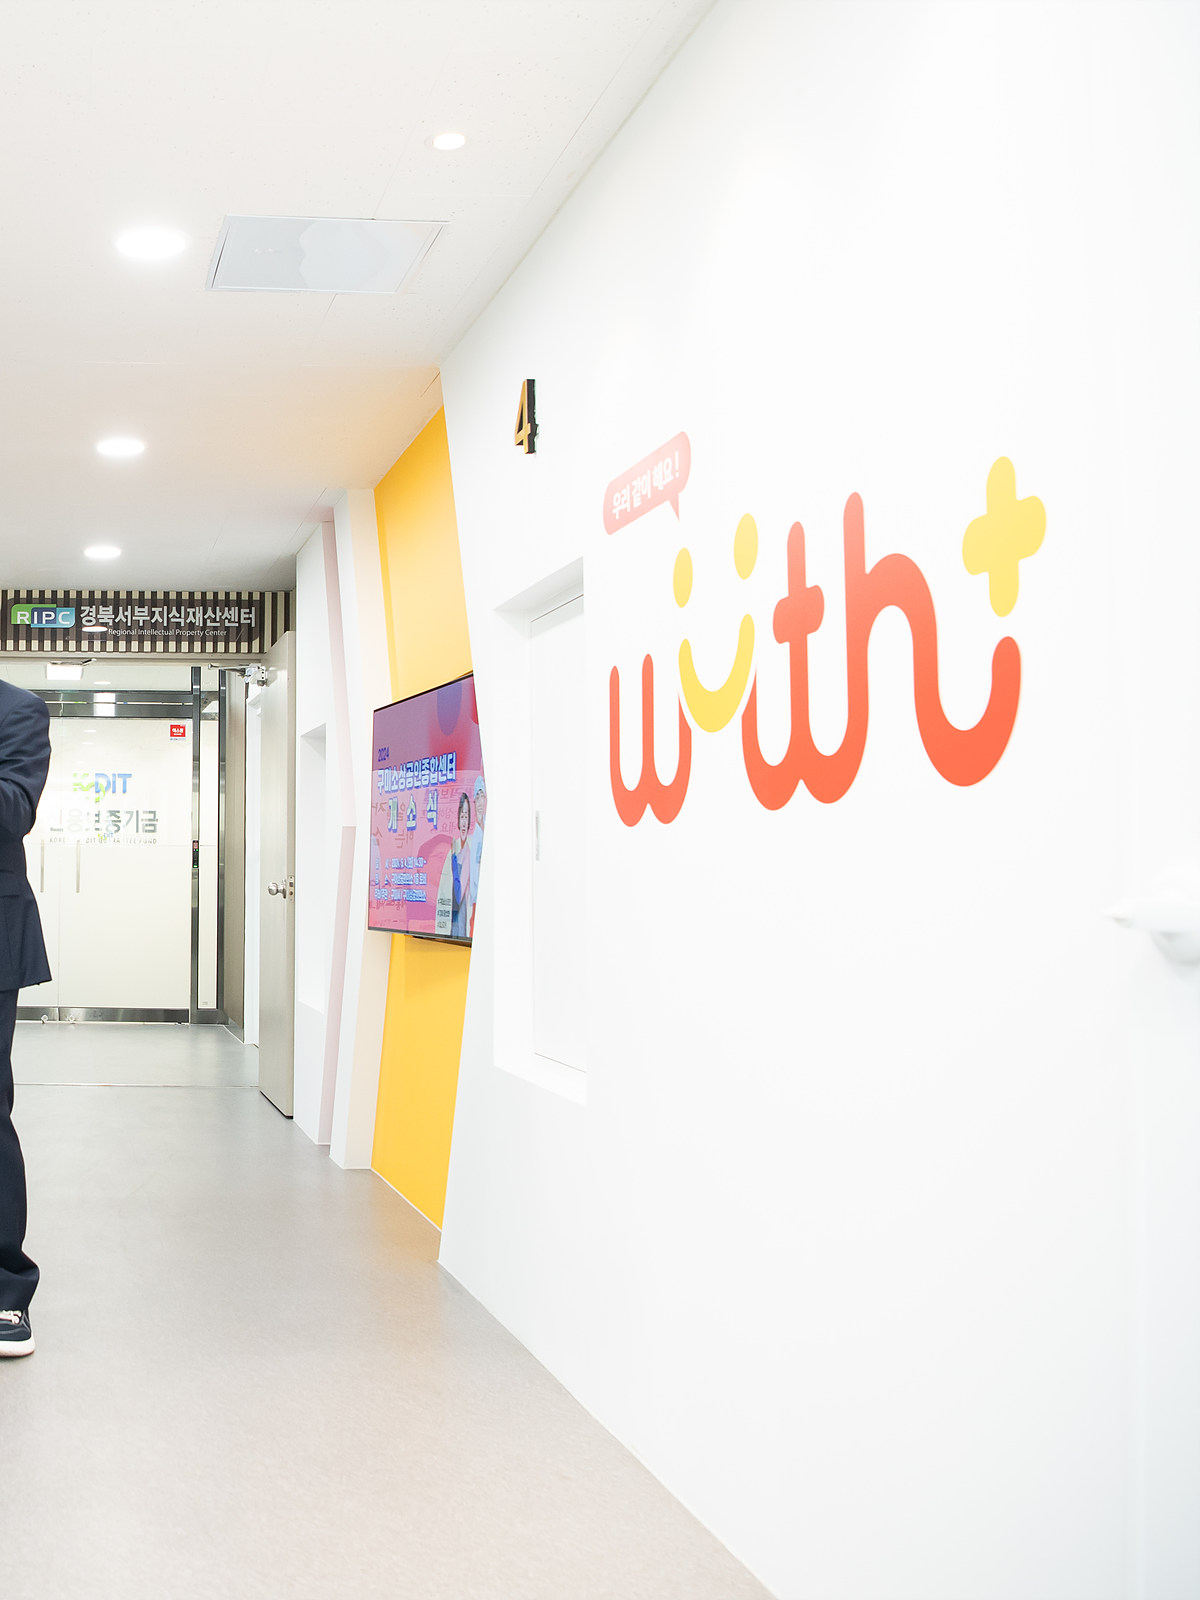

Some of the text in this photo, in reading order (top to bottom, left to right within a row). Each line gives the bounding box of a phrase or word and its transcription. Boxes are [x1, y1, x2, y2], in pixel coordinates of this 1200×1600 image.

[514, 379, 536, 454] 4
[612, 484, 631, 520] 우리
[632, 470, 651, 508] 같이
[16, 605, 256, 627] RIPC 경북서부지식재산센터
[108, 628, 137, 637] Regional
[138, 628, 175, 636] Intellectual
[175, 629, 203, 637] Property
[377, 750, 457, 794] 구미소상공인종합센터
[406, 794, 417, 831] 소
[426, 789, 438, 829] 식
